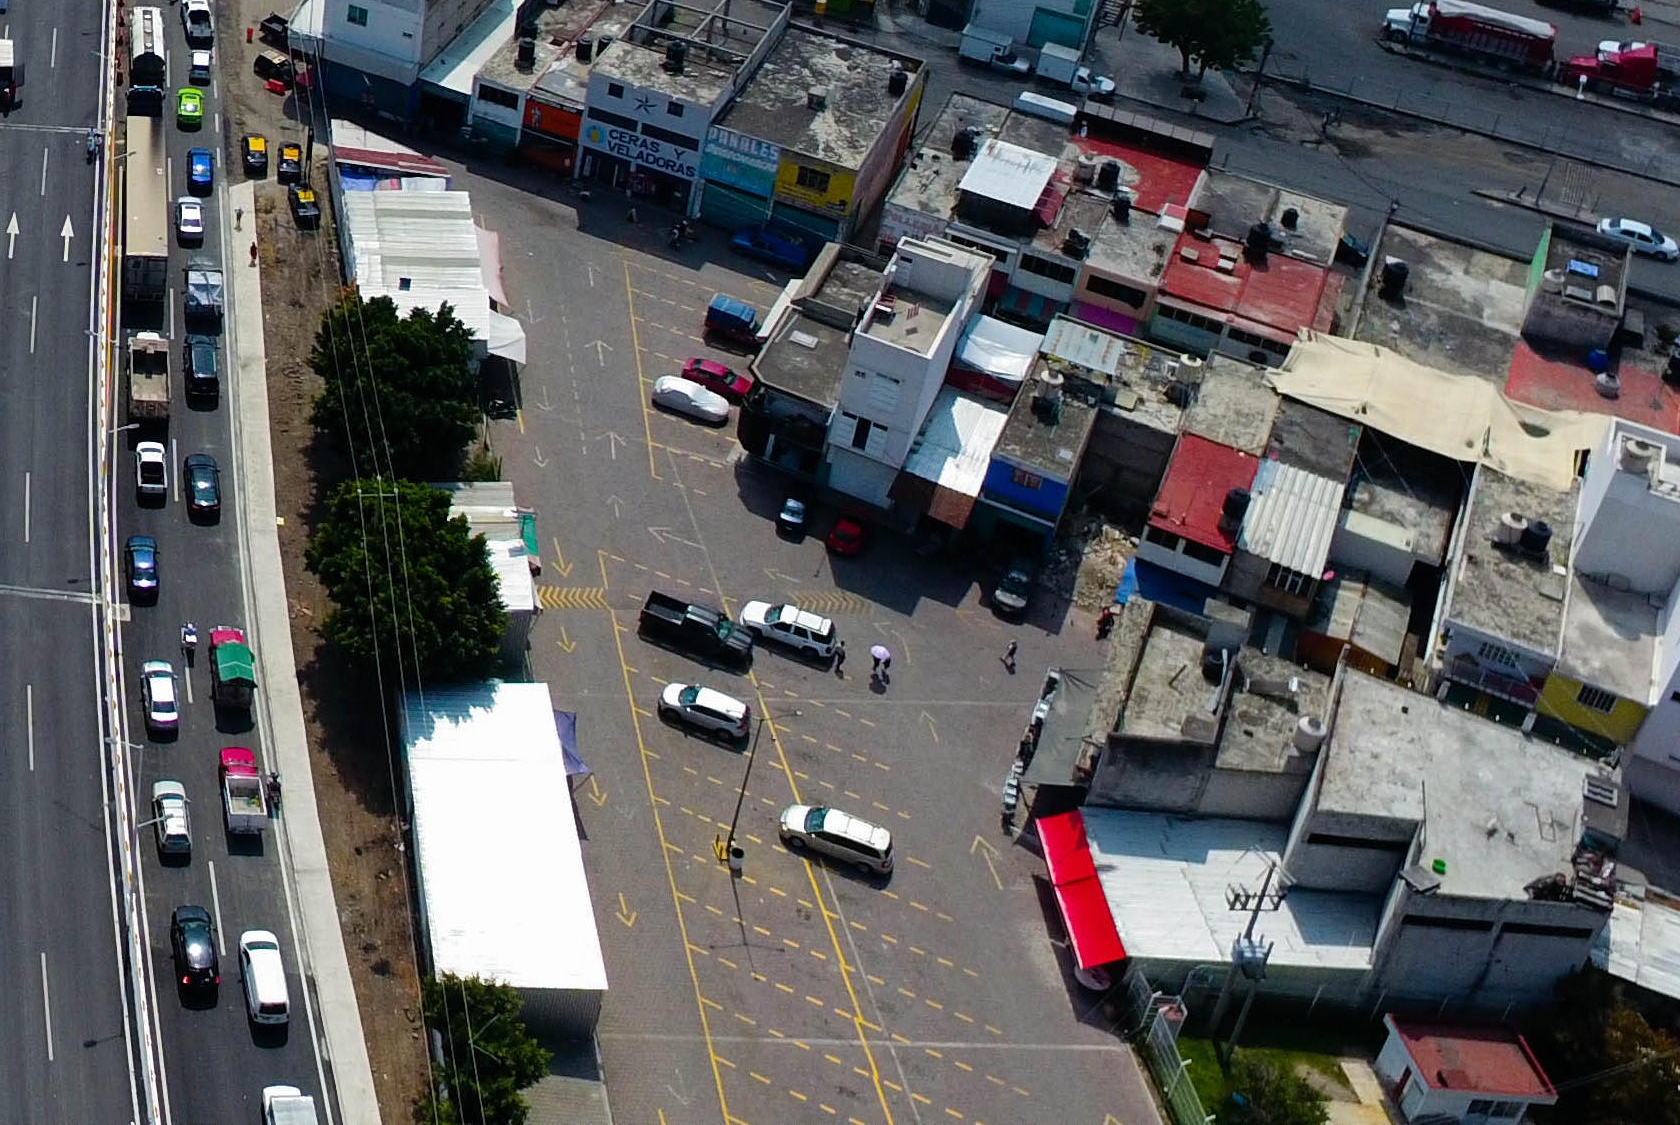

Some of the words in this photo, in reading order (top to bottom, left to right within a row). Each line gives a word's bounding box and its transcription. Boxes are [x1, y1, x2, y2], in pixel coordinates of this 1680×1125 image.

[607, 139, 697, 178] VELADORAS
[608, 128, 660, 154] CERAS
[674, 147, 687, 161] Y
